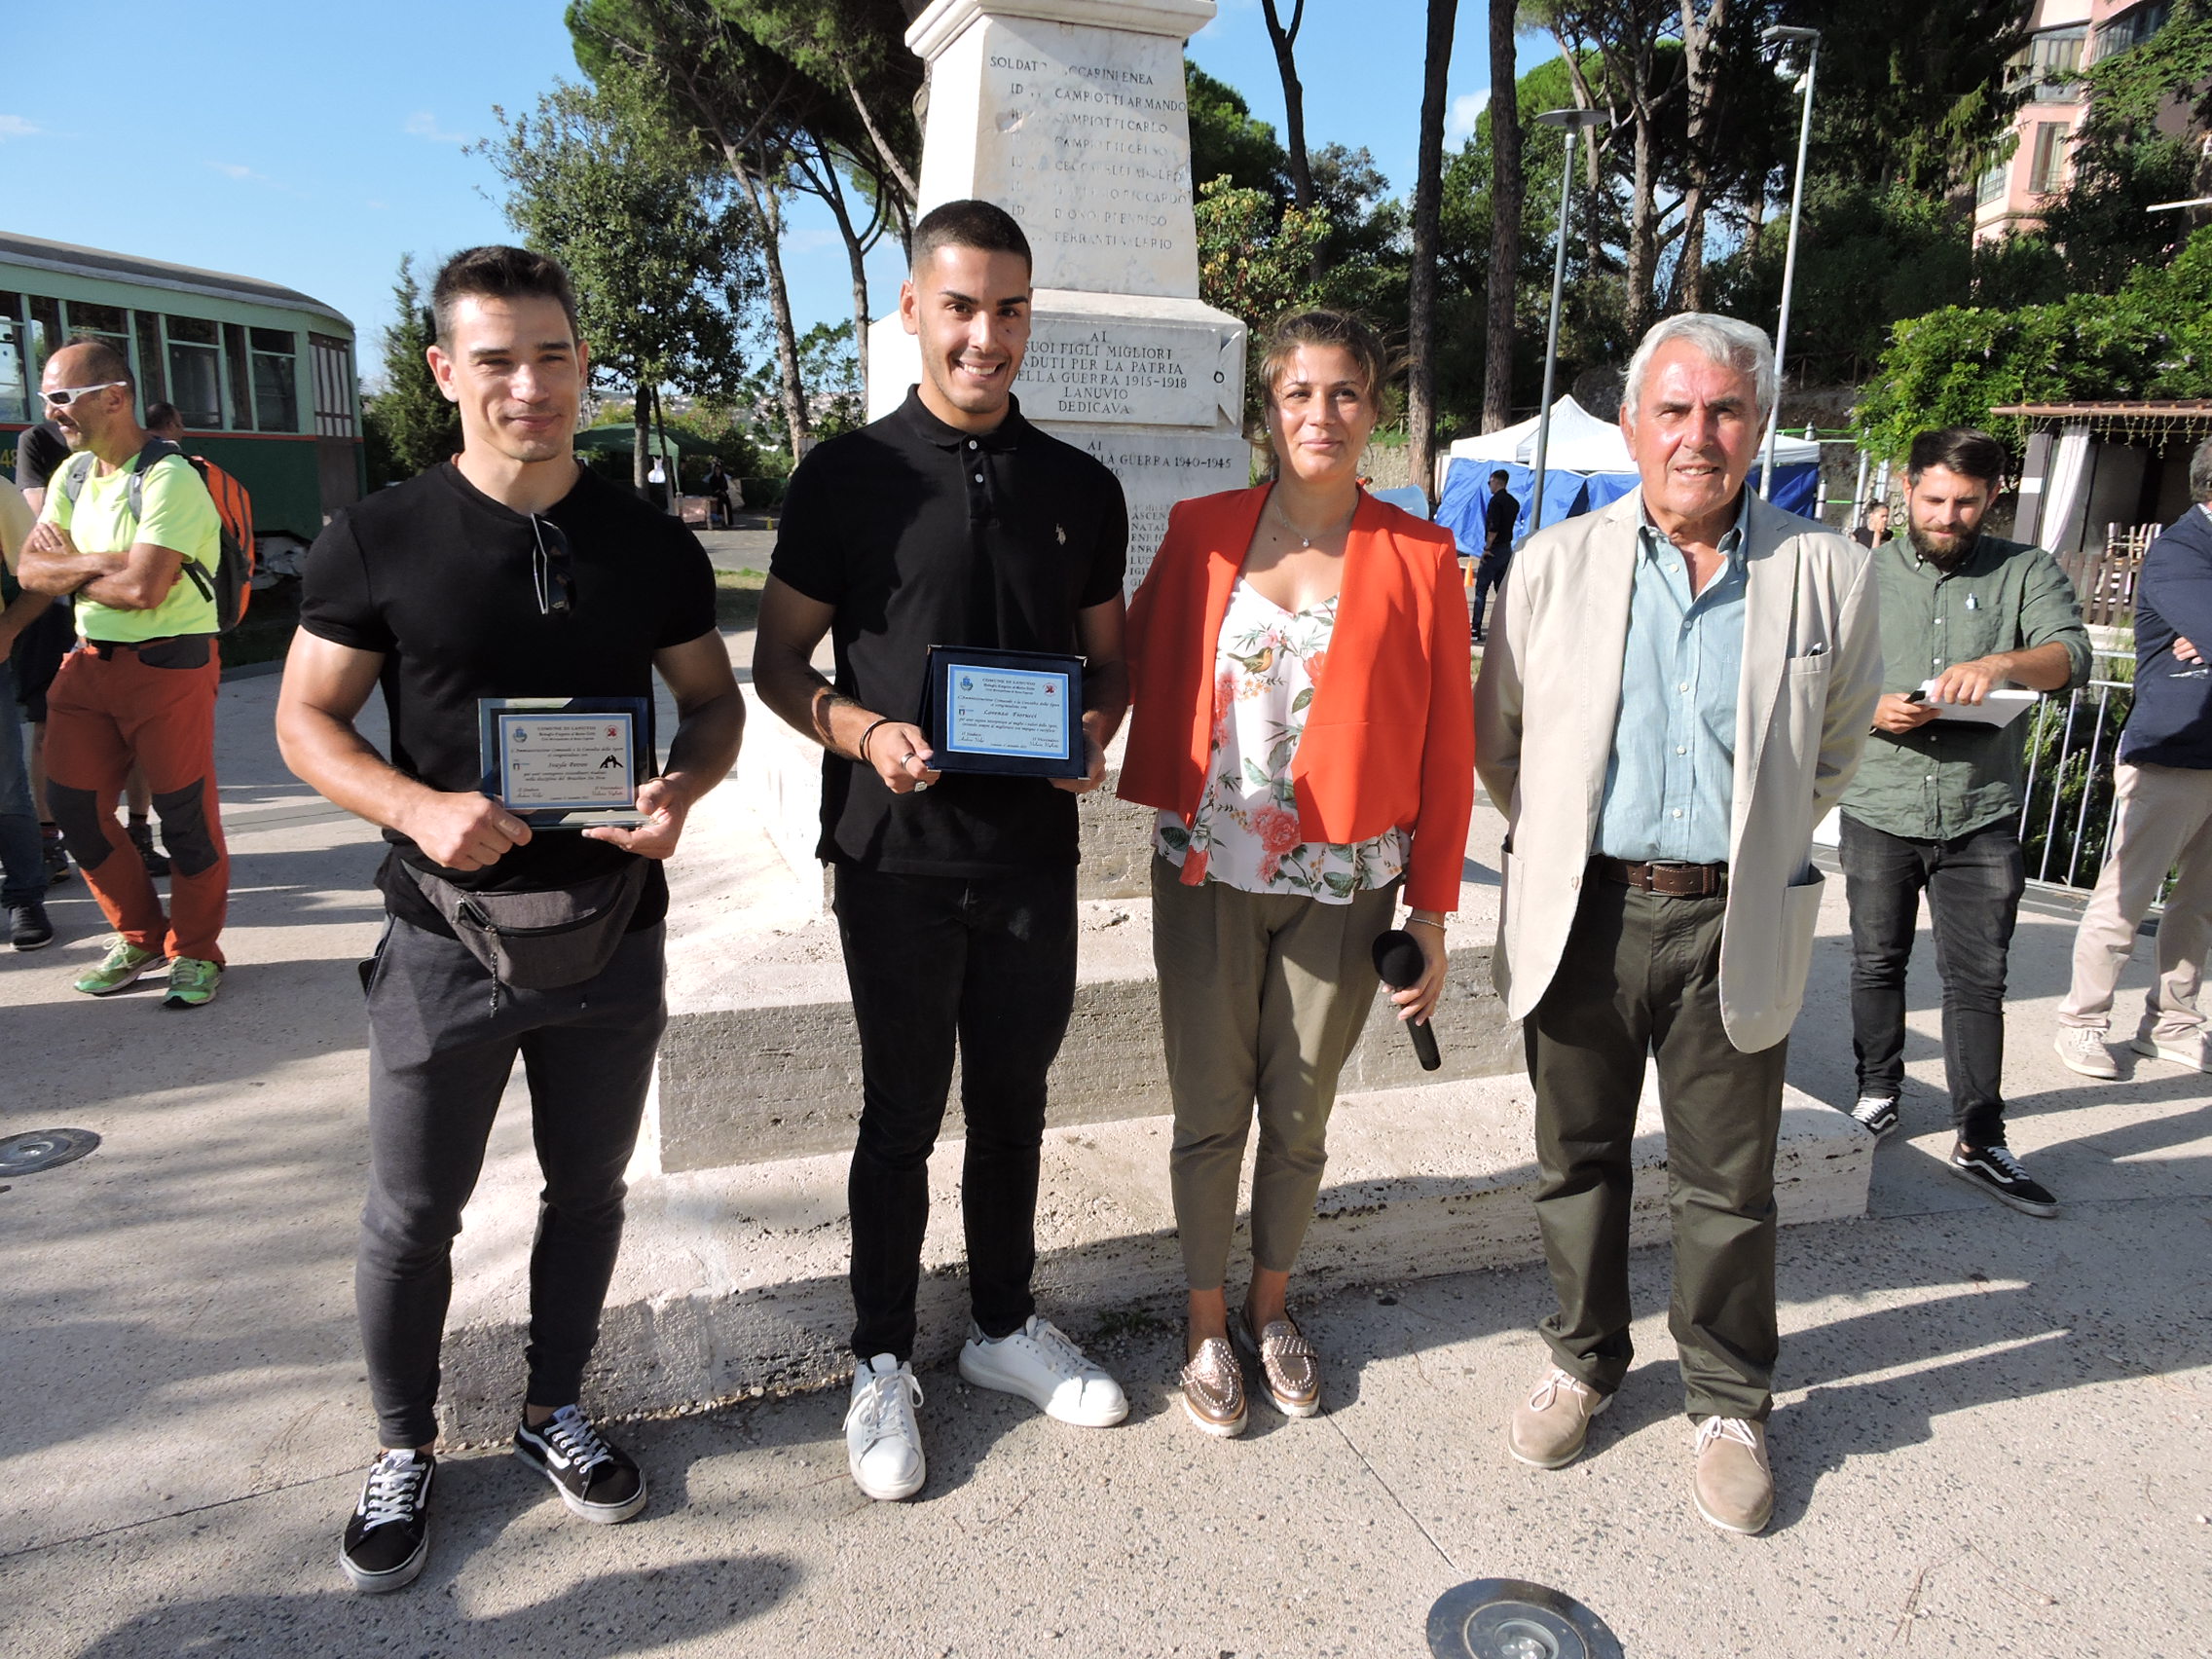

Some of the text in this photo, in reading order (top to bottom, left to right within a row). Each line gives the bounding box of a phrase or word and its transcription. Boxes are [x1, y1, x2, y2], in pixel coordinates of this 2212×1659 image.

[1122, 71, 1154, 85] ENEA
[1127, 94, 1186, 112] ARMANDO
[1127, 120, 1168, 133] CARLO
[1090, 331, 1107, 342] AI
[1060, 343, 1099, 357] FIGLI
[1106, 345, 1172, 360] MIGLIORI
[1071, 359, 1098, 371] PER
[1106, 360, 1124, 372] LA
[1131, 362, 1184, 375] PATRIA
[1017, 369, 1187, 389] ELLA GUERRA 1915-1918
[1064, 387, 1129, 400] LANUVIO
[1058, 400, 1130, 414] DEDICAVA
[1087, 441, 1102, 451] AI
[1120, 455, 1173, 467] GUERRA
[1175, 456, 1232, 468] 1940-1945
[1131, 512, 1166, 520] ASCEN
[1131, 522, 1165, 531] NATAL
[1130, 545, 1158, 553] ENRI
